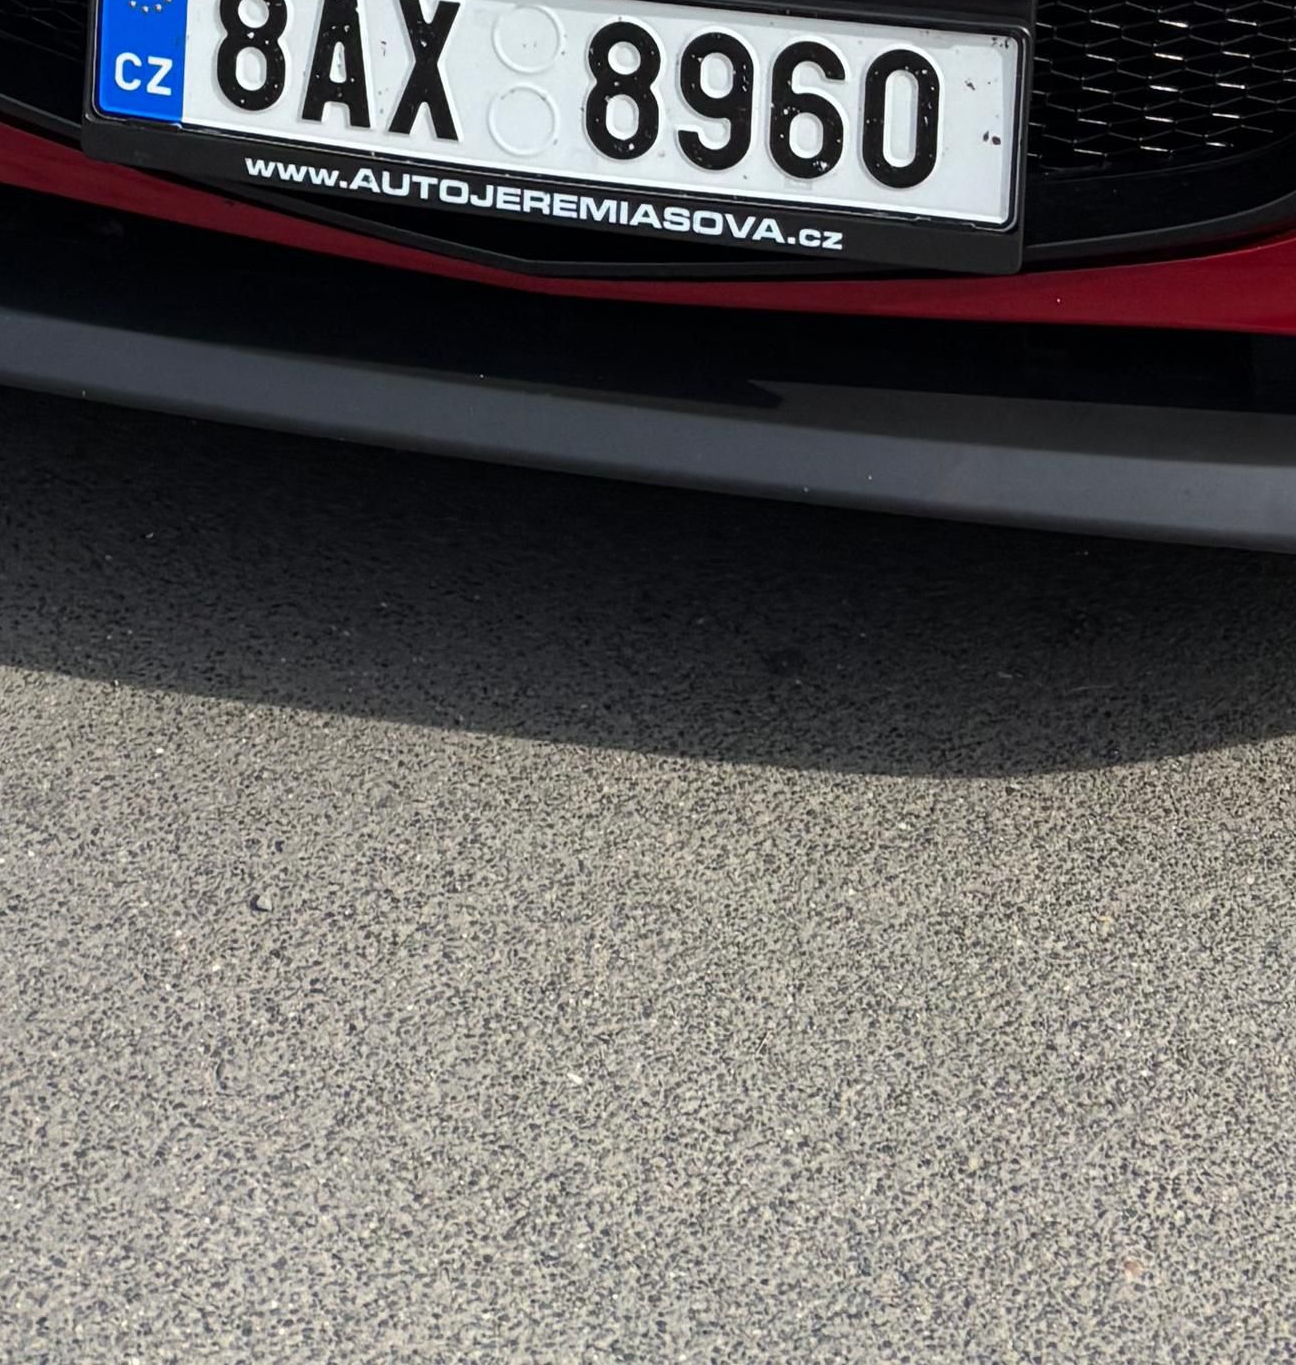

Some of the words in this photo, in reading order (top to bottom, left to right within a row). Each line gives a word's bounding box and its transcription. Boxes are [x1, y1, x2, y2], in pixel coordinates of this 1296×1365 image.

[114, 51, 174, 97] CZ
[584, 20, 941, 190] 8960
[244, 156, 844, 251] www.AUTOJEREMIASOVA.cz
